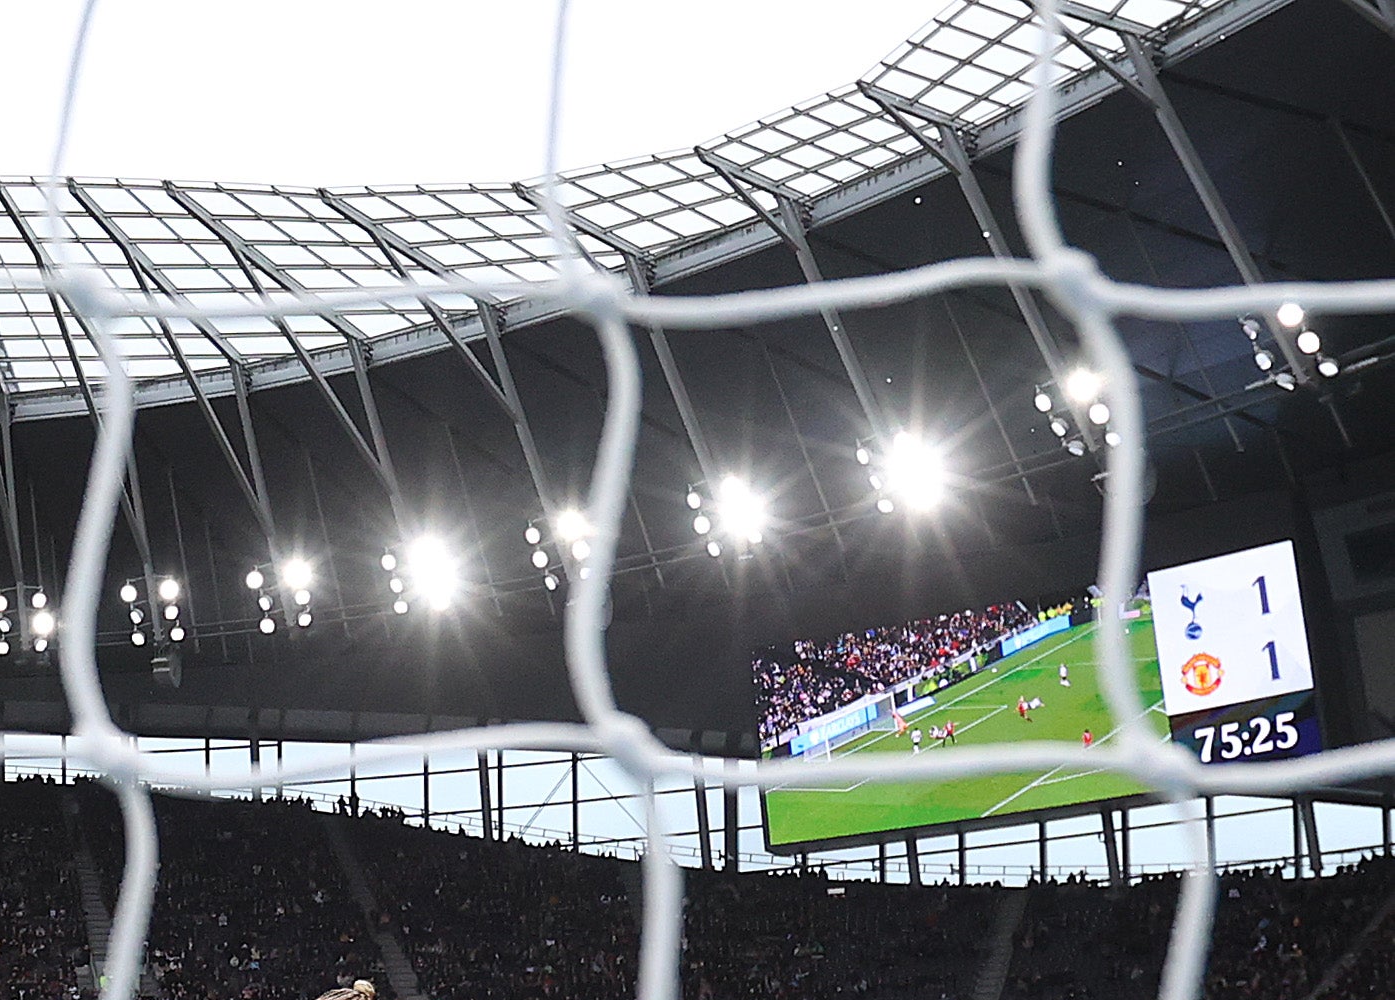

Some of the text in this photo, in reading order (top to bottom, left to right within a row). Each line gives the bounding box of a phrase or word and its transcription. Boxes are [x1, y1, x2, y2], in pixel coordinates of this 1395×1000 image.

[1251, 576, 1271, 615] 1
[1261, 641, 1281, 681] 1
[1194, 712, 1299, 763] 75:25
